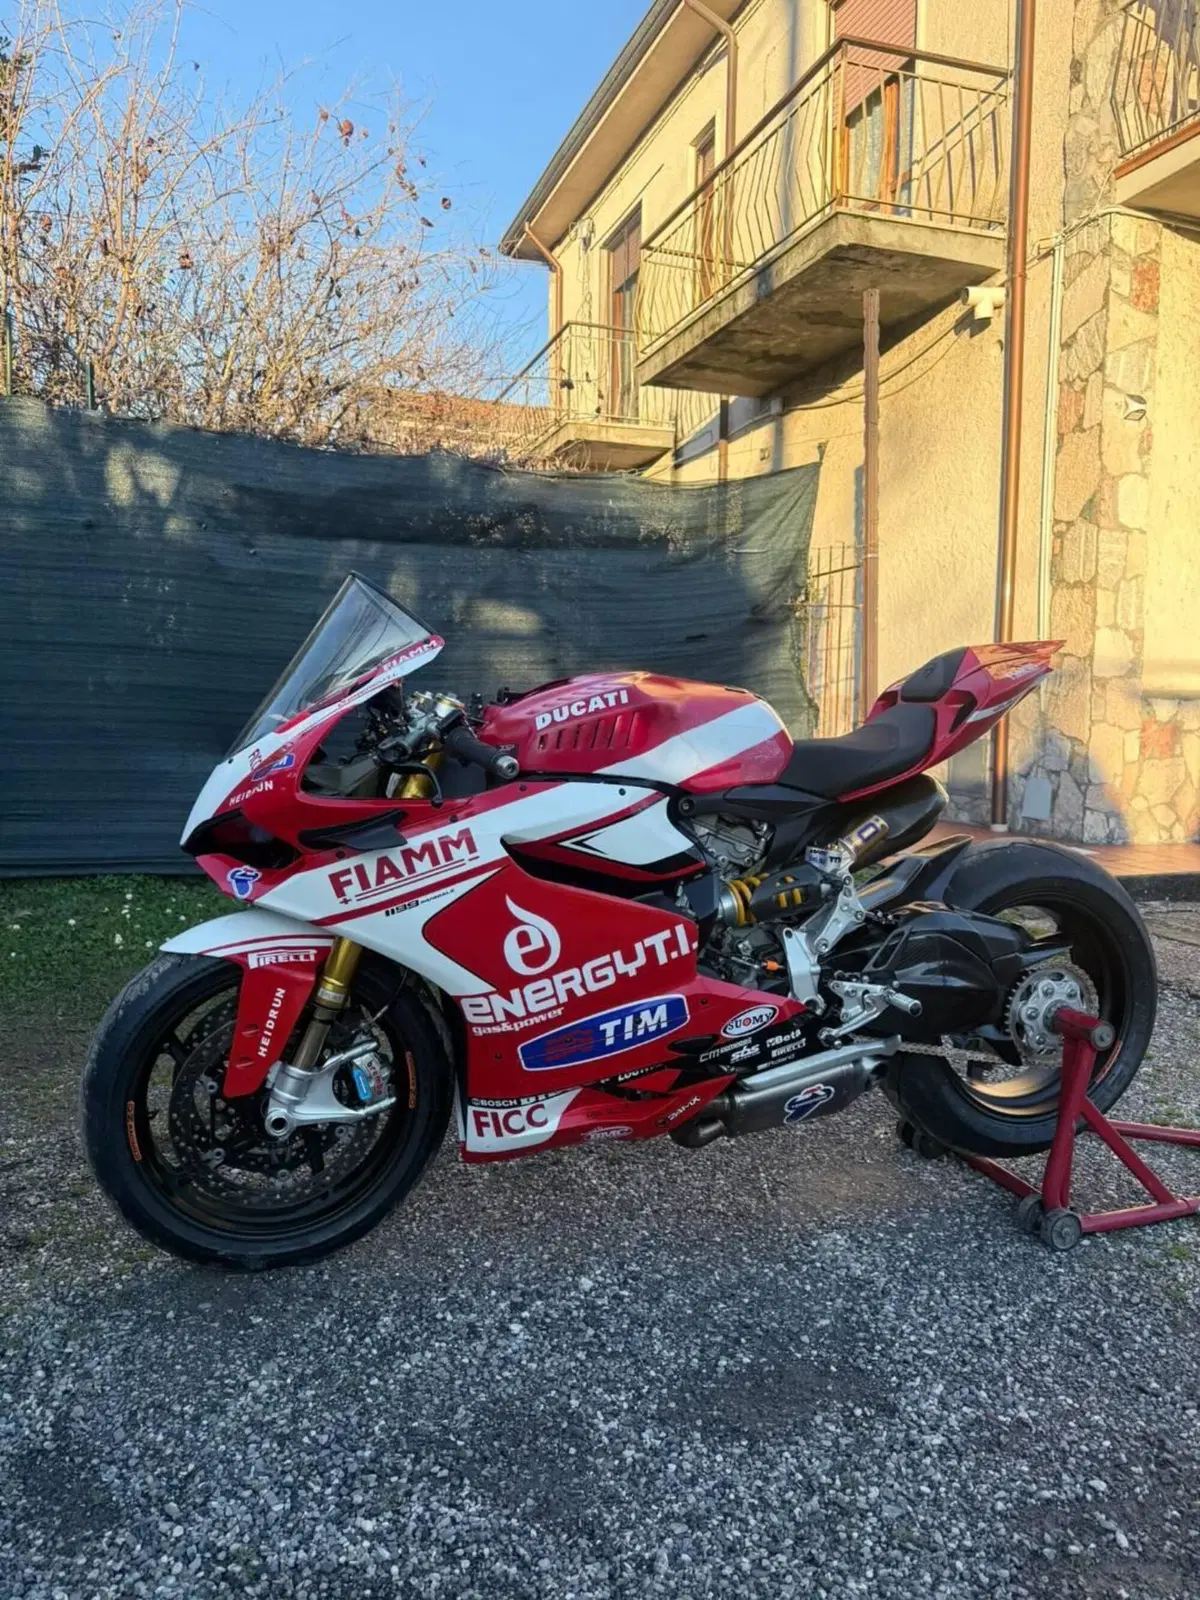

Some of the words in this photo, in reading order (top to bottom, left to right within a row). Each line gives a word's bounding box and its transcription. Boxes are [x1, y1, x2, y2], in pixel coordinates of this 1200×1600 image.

[535, 690, 629, 730] DUCATI
[328, 827, 478, 898] FIAMM
[248, 949, 317, 969] PIRELLI
[257, 987, 286, 1058] HEIDRUN
[472, 1007, 564, 1036] gas&power
[600, 1004, 668, 1046] TIM
[727, 1011, 772, 1031] SUOMY
[775, 1029, 802, 1046] Beta
[480, 1099, 518, 1107] BOSCH
[472, 1103, 549, 1138] FICC
